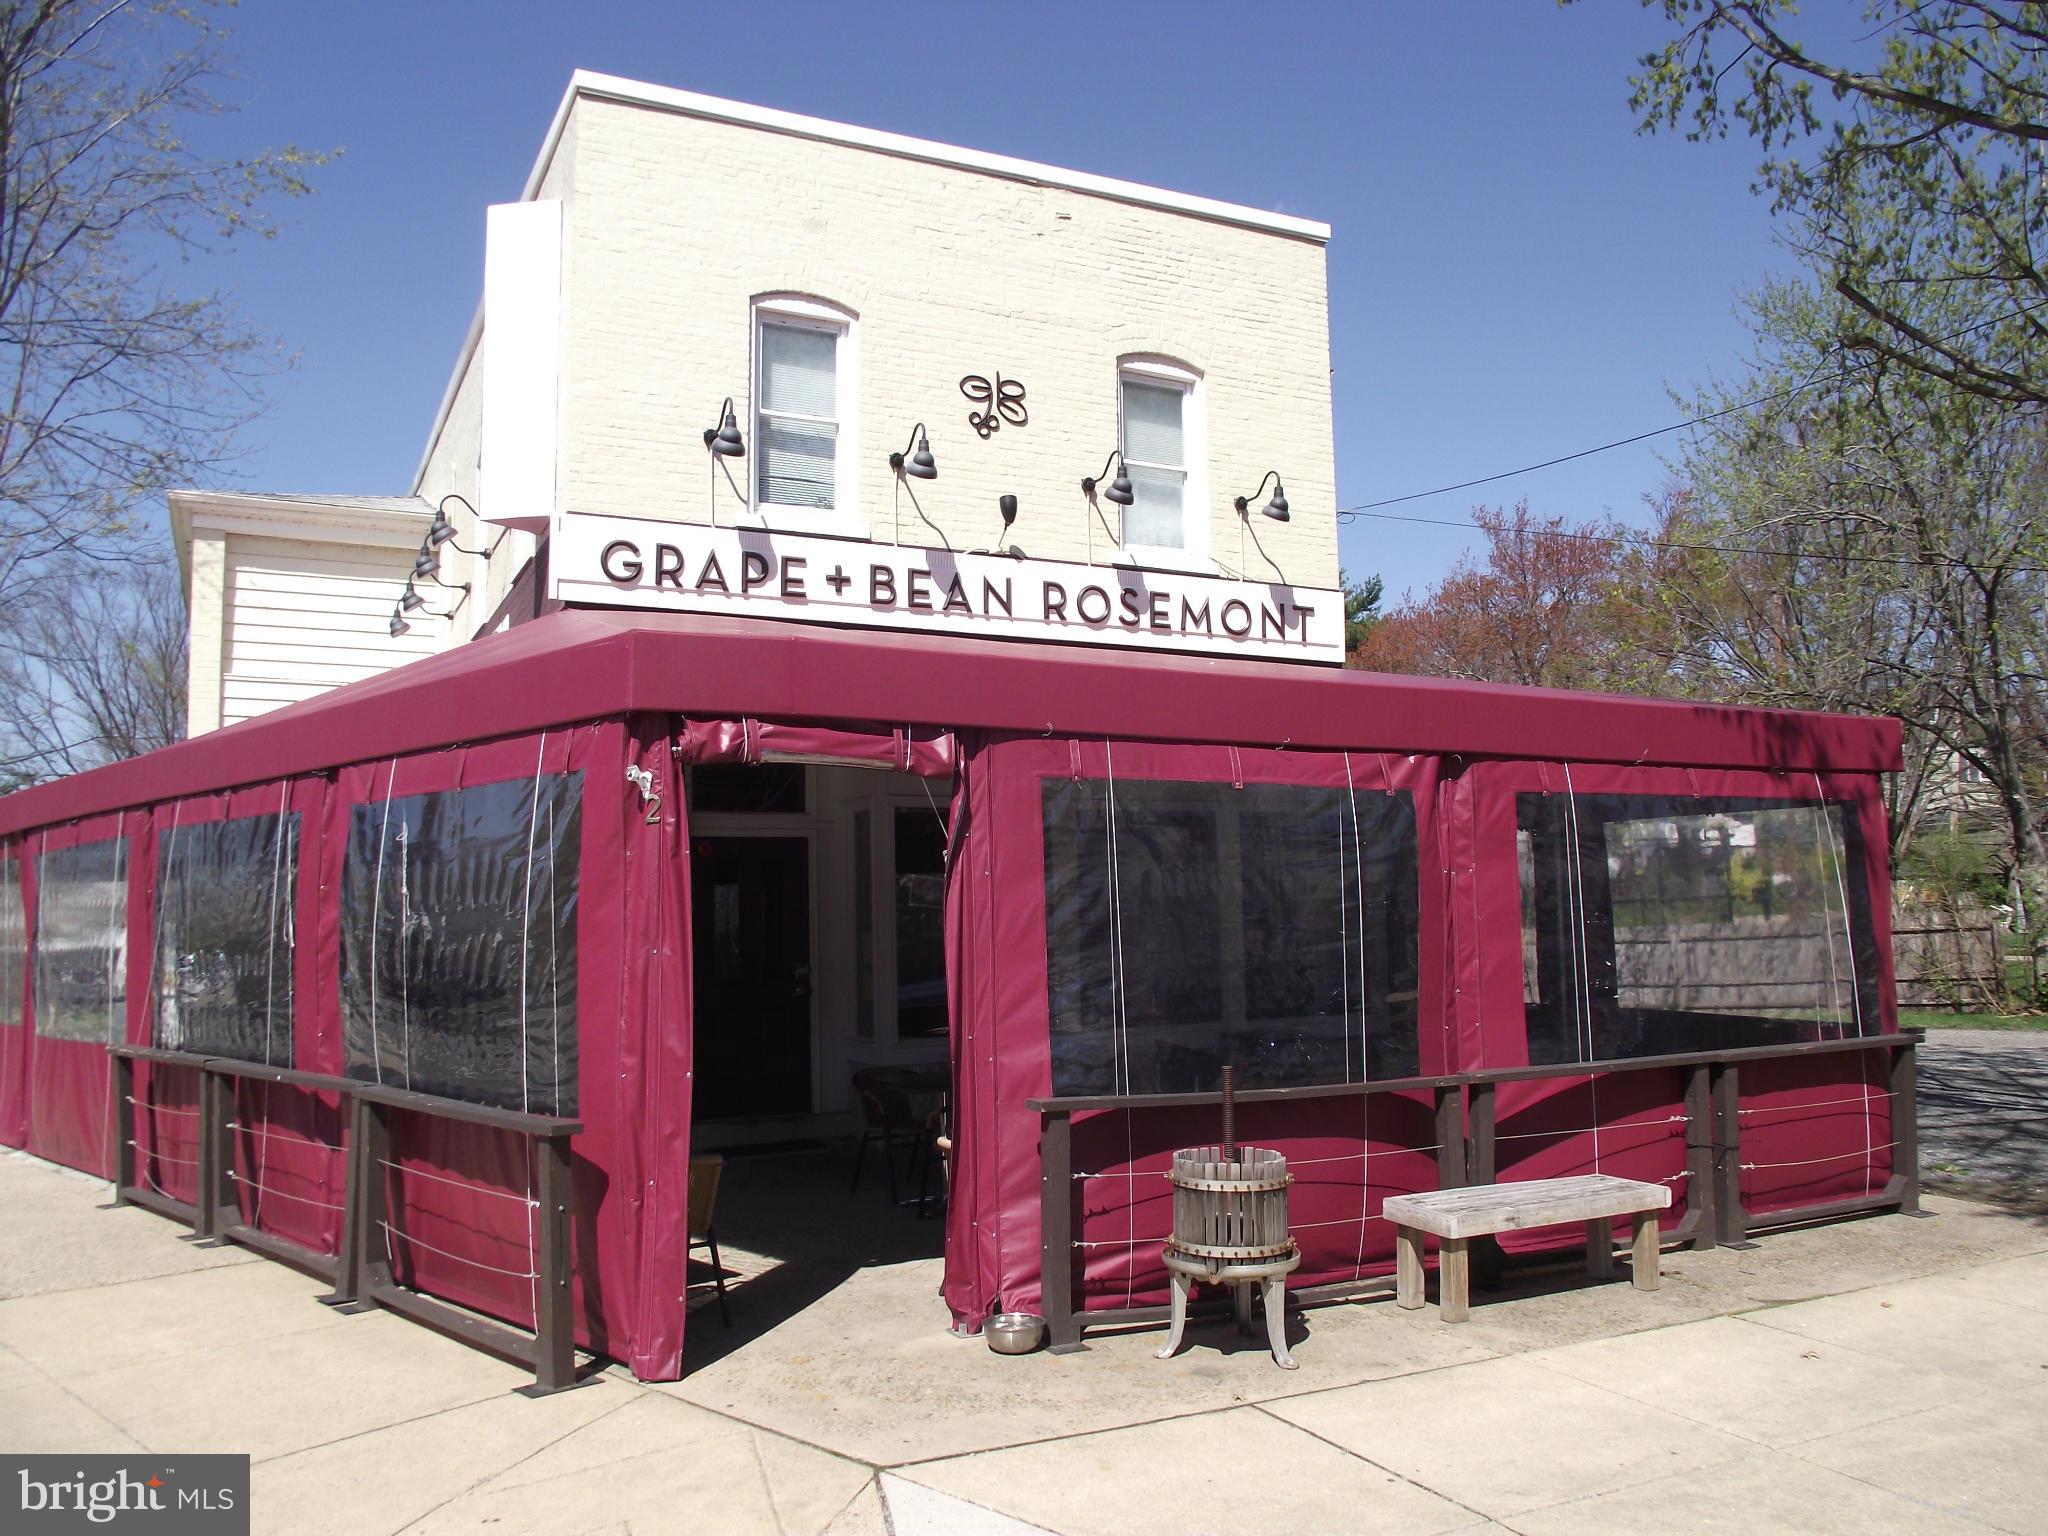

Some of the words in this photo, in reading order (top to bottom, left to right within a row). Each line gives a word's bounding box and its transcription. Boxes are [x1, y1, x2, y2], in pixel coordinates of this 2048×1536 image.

[601, 541, 807, 598] GRAPE
[869, 564, 1012, 616] BEAN
[1043, 582, 1315, 641] ROSEMONT
[646, 793, 662, 824] 2
